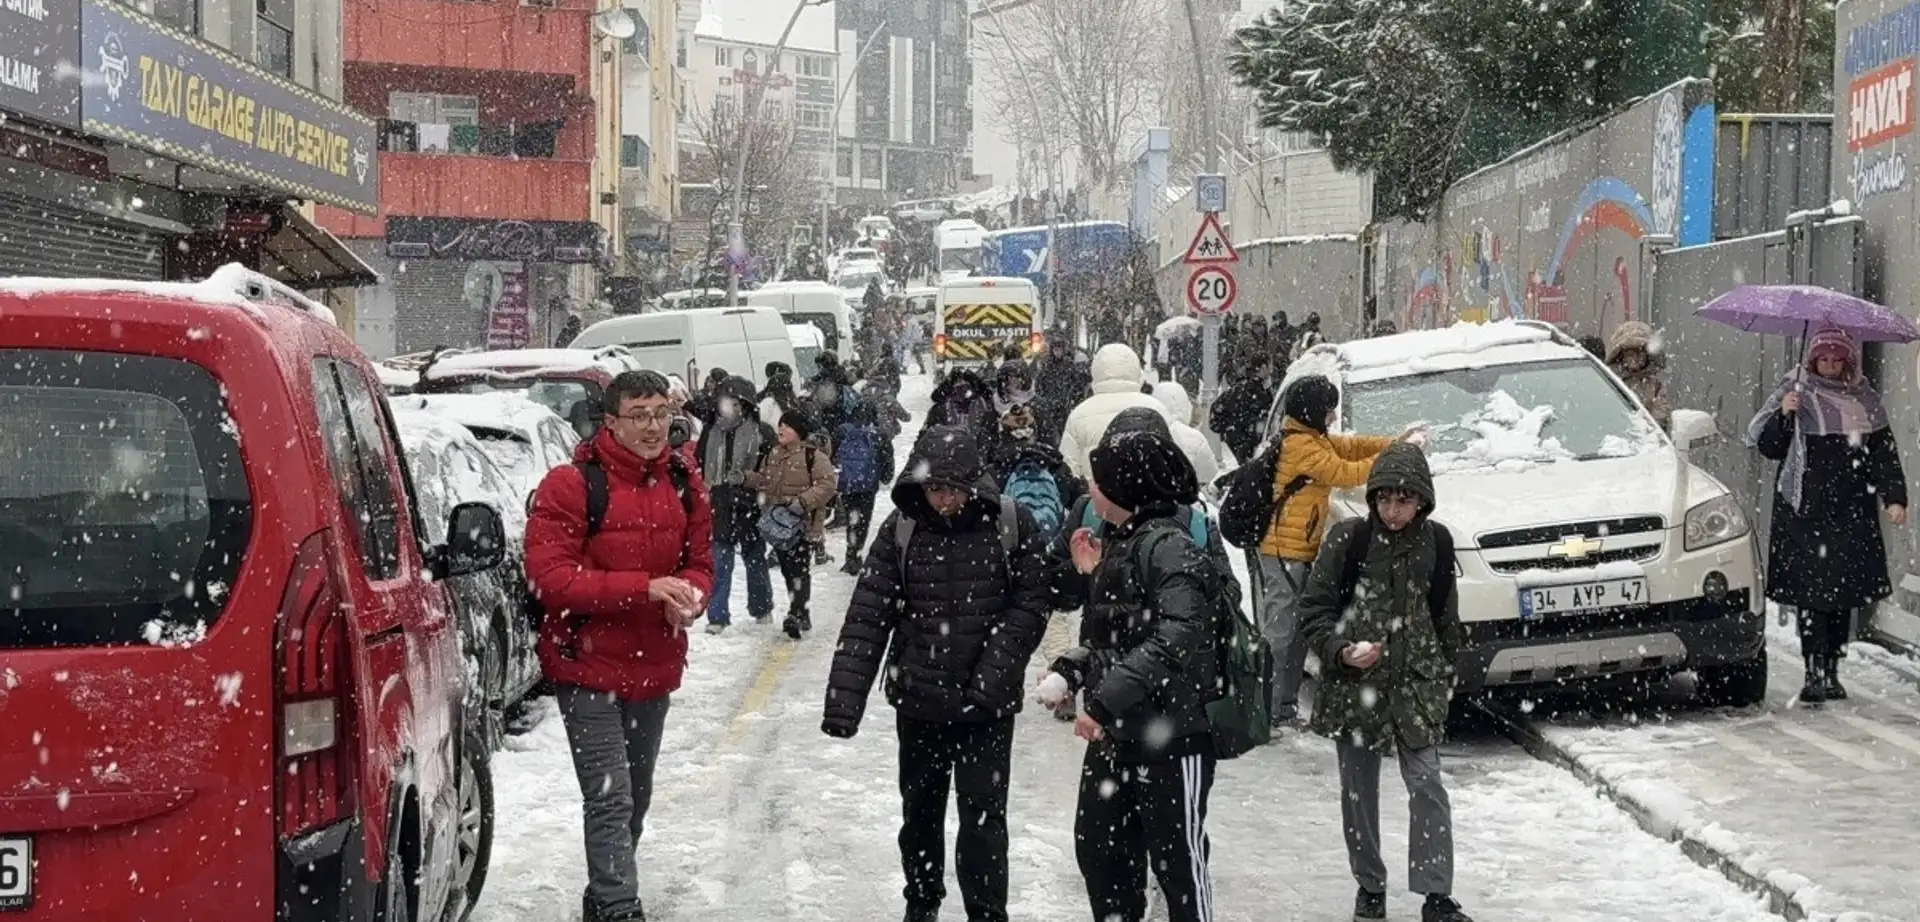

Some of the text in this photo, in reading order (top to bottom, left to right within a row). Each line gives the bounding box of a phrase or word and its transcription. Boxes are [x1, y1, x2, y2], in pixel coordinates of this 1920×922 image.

[140, 55, 349, 177] TAXI GARAGE AUTO SERVICE
[1852, 69, 1911, 142] HAYAT
[1197, 277, 1227, 301] 20
[952, 327, 1029, 340] OKUL TAŞITI
[1534, 581, 1642, 611] 34 AYP 47
[0, 847, 19, 890] 6
